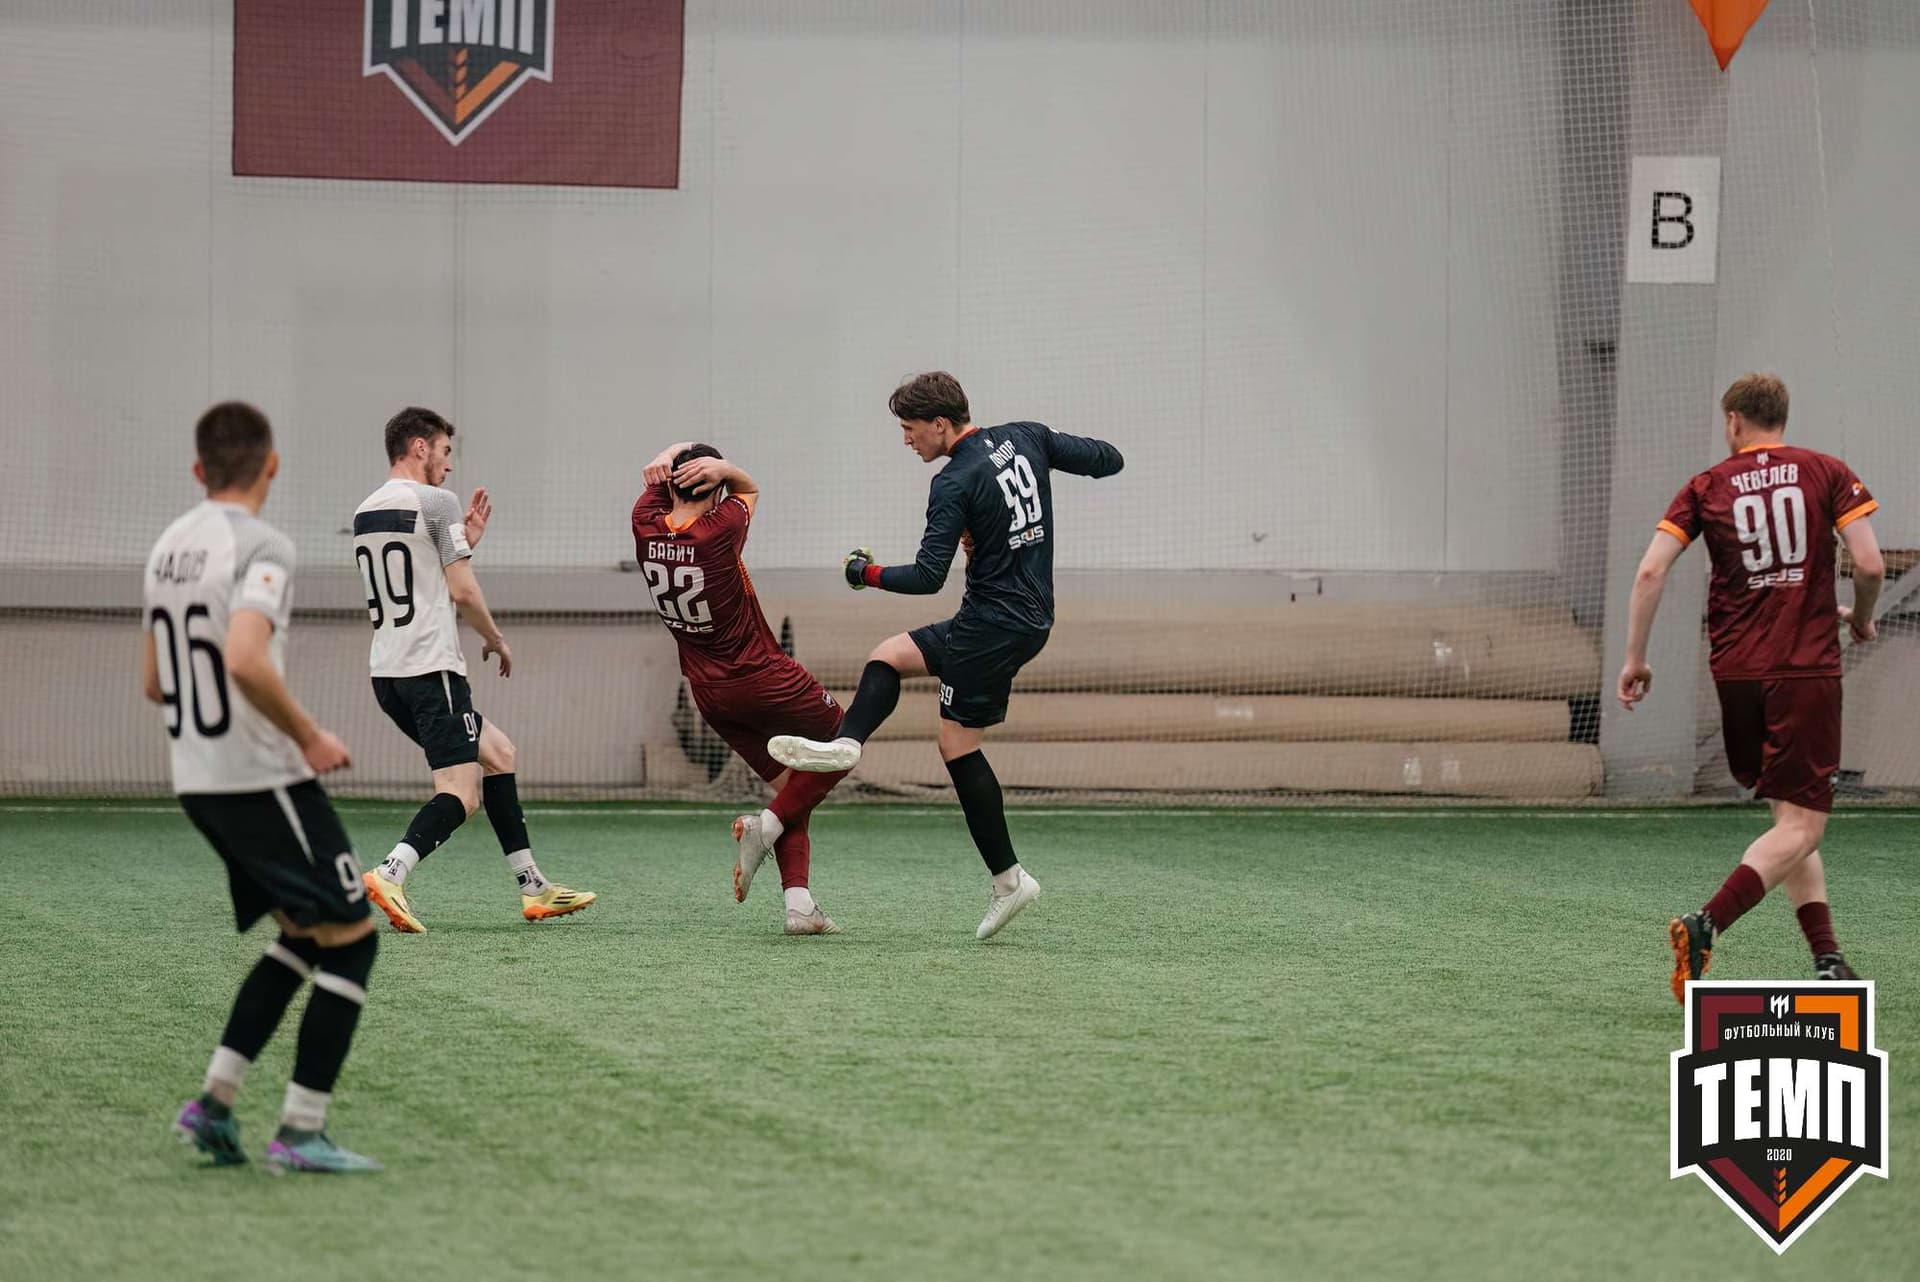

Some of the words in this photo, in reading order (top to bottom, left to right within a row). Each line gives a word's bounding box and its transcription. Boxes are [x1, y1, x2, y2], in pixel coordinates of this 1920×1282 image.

[996, 454, 1042, 532] 59
[1731, 463, 1799, 493] ЧЕВЕЛЕВ
[648, 541, 695, 563] БАБИЧ
[1733, 486, 1807, 573] 90
[643, 560, 713, 624] 22
[151, 603, 230, 738] 96
